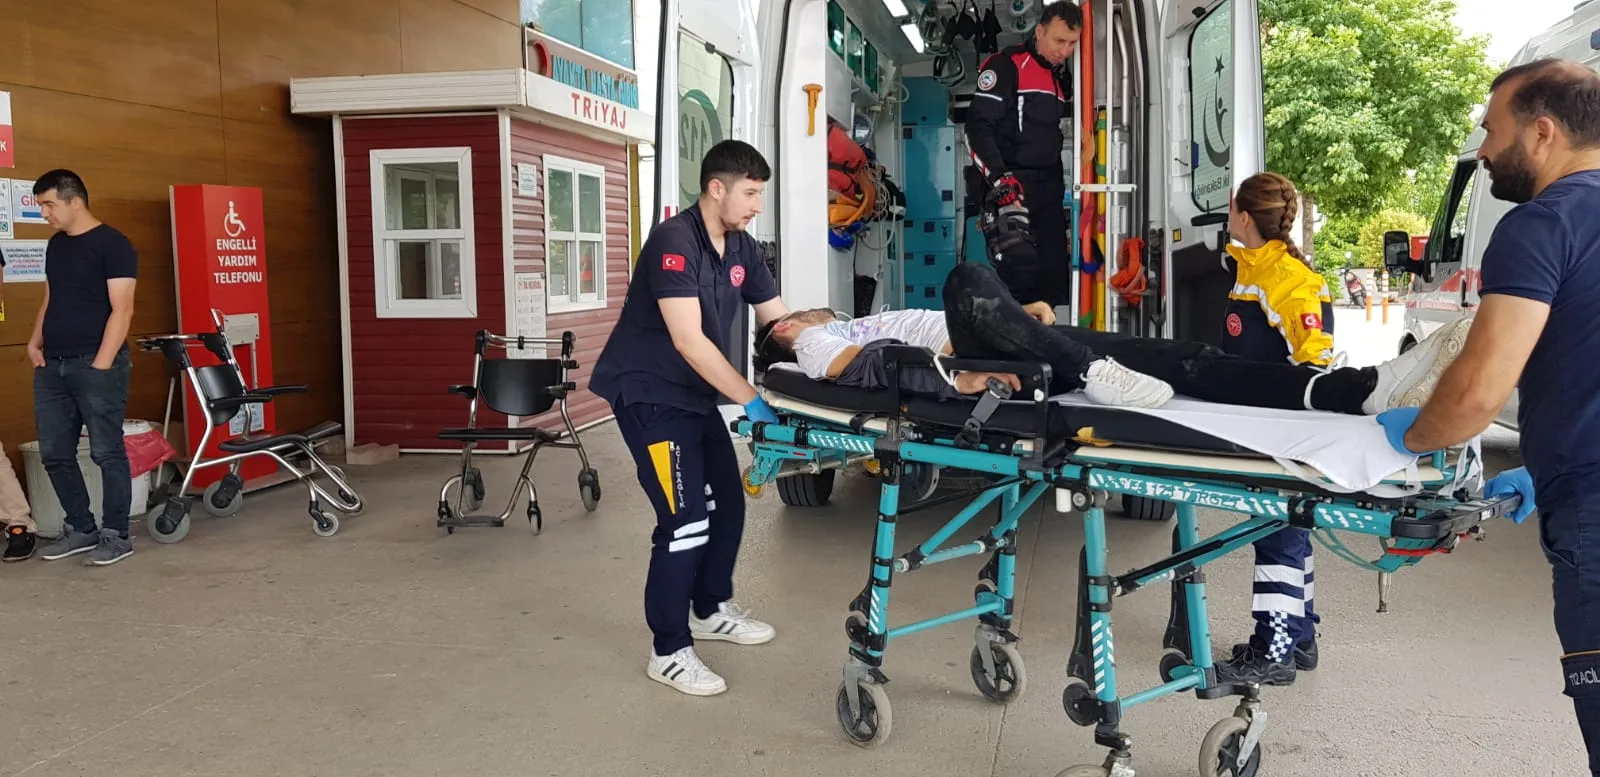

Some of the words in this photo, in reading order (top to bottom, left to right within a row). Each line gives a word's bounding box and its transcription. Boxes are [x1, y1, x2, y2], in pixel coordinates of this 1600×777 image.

[216, 236, 257, 250] ENGELLİ
[218, 255, 257, 266] YARDIM
[213, 271, 263, 284] TELEFONU
